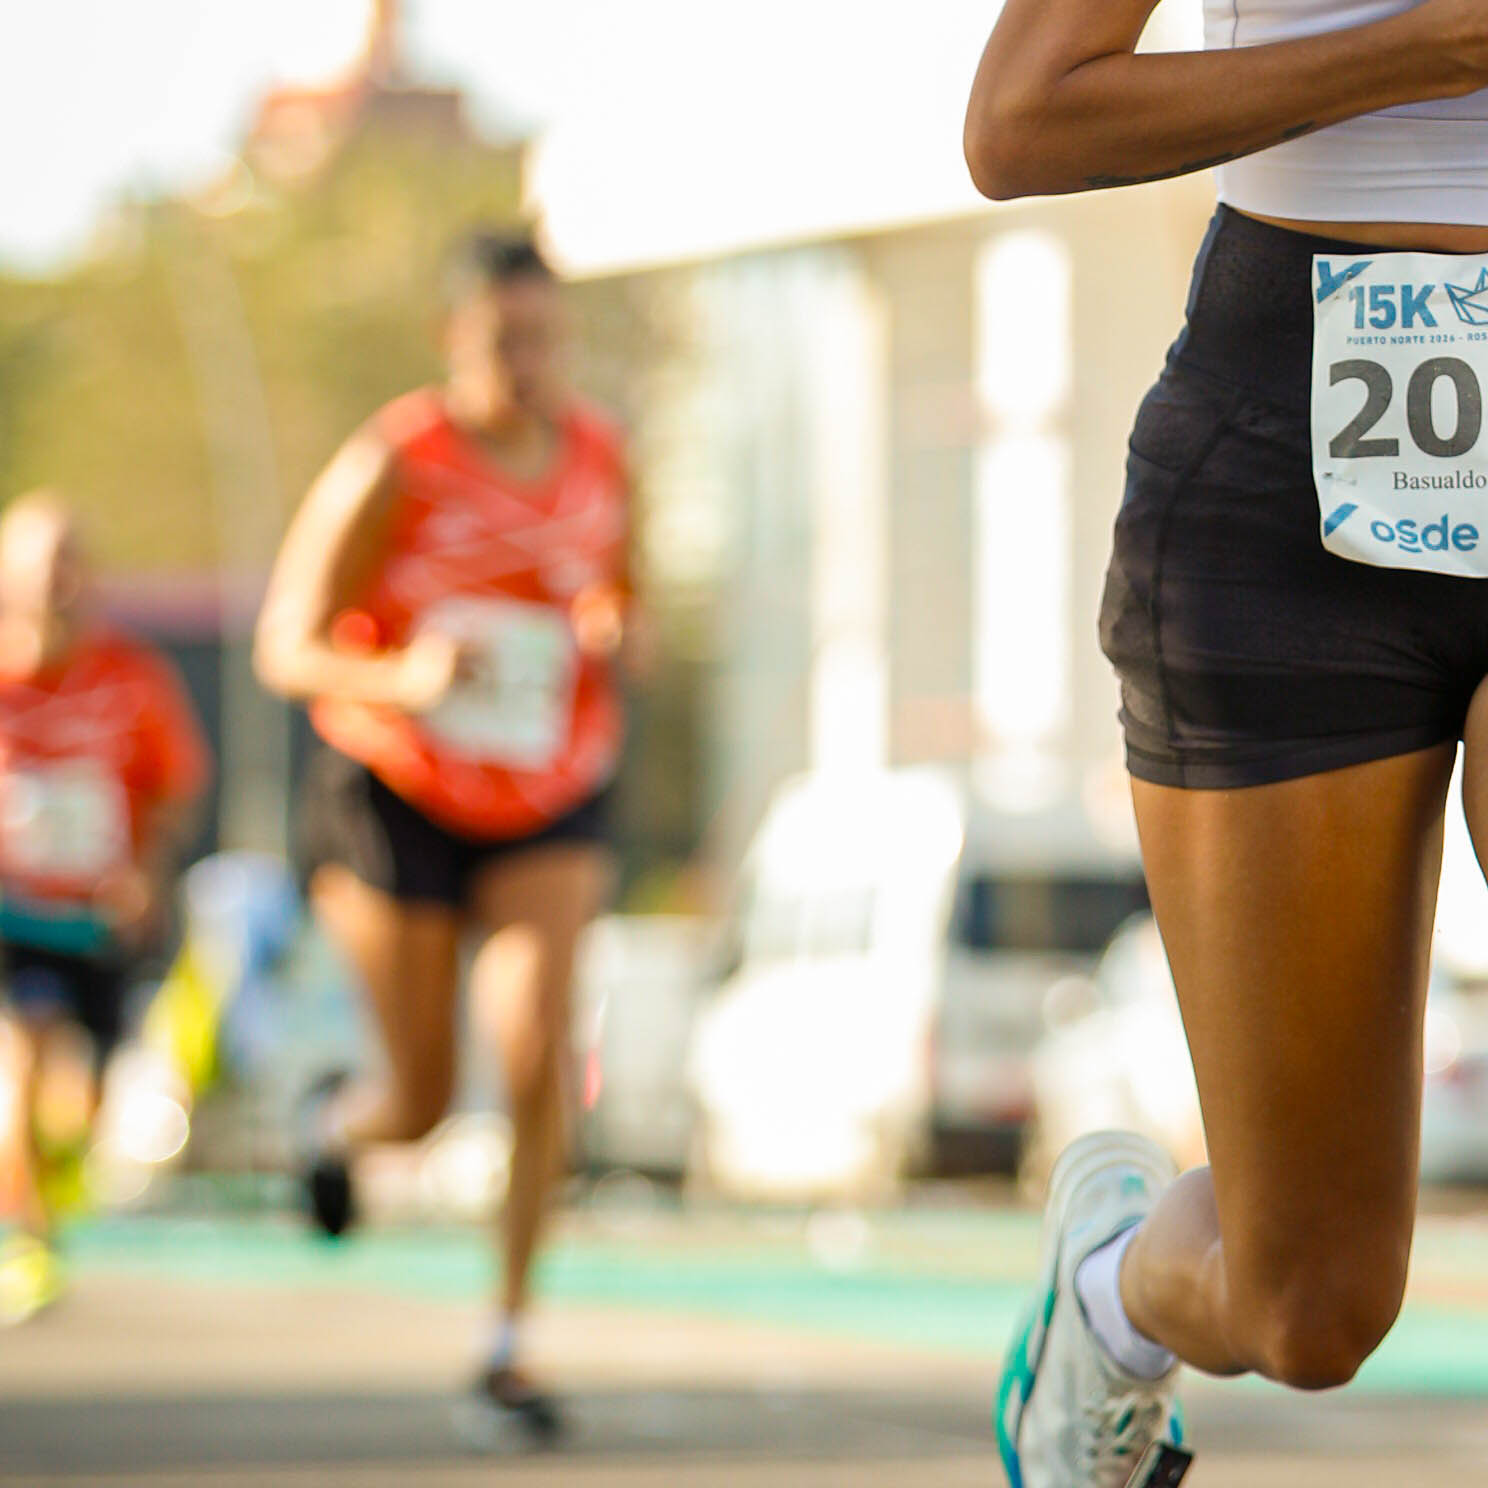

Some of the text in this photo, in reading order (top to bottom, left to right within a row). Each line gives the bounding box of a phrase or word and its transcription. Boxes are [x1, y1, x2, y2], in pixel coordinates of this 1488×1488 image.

[1346, 284, 1438, 330] 15K
[1346, 335, 1387, 345] PUERTO
[1390, 335, 1425, 345] NORTE
[1392, 470, 1487, 491] Basualdo
[1370, 513, 1480, 553] osde
